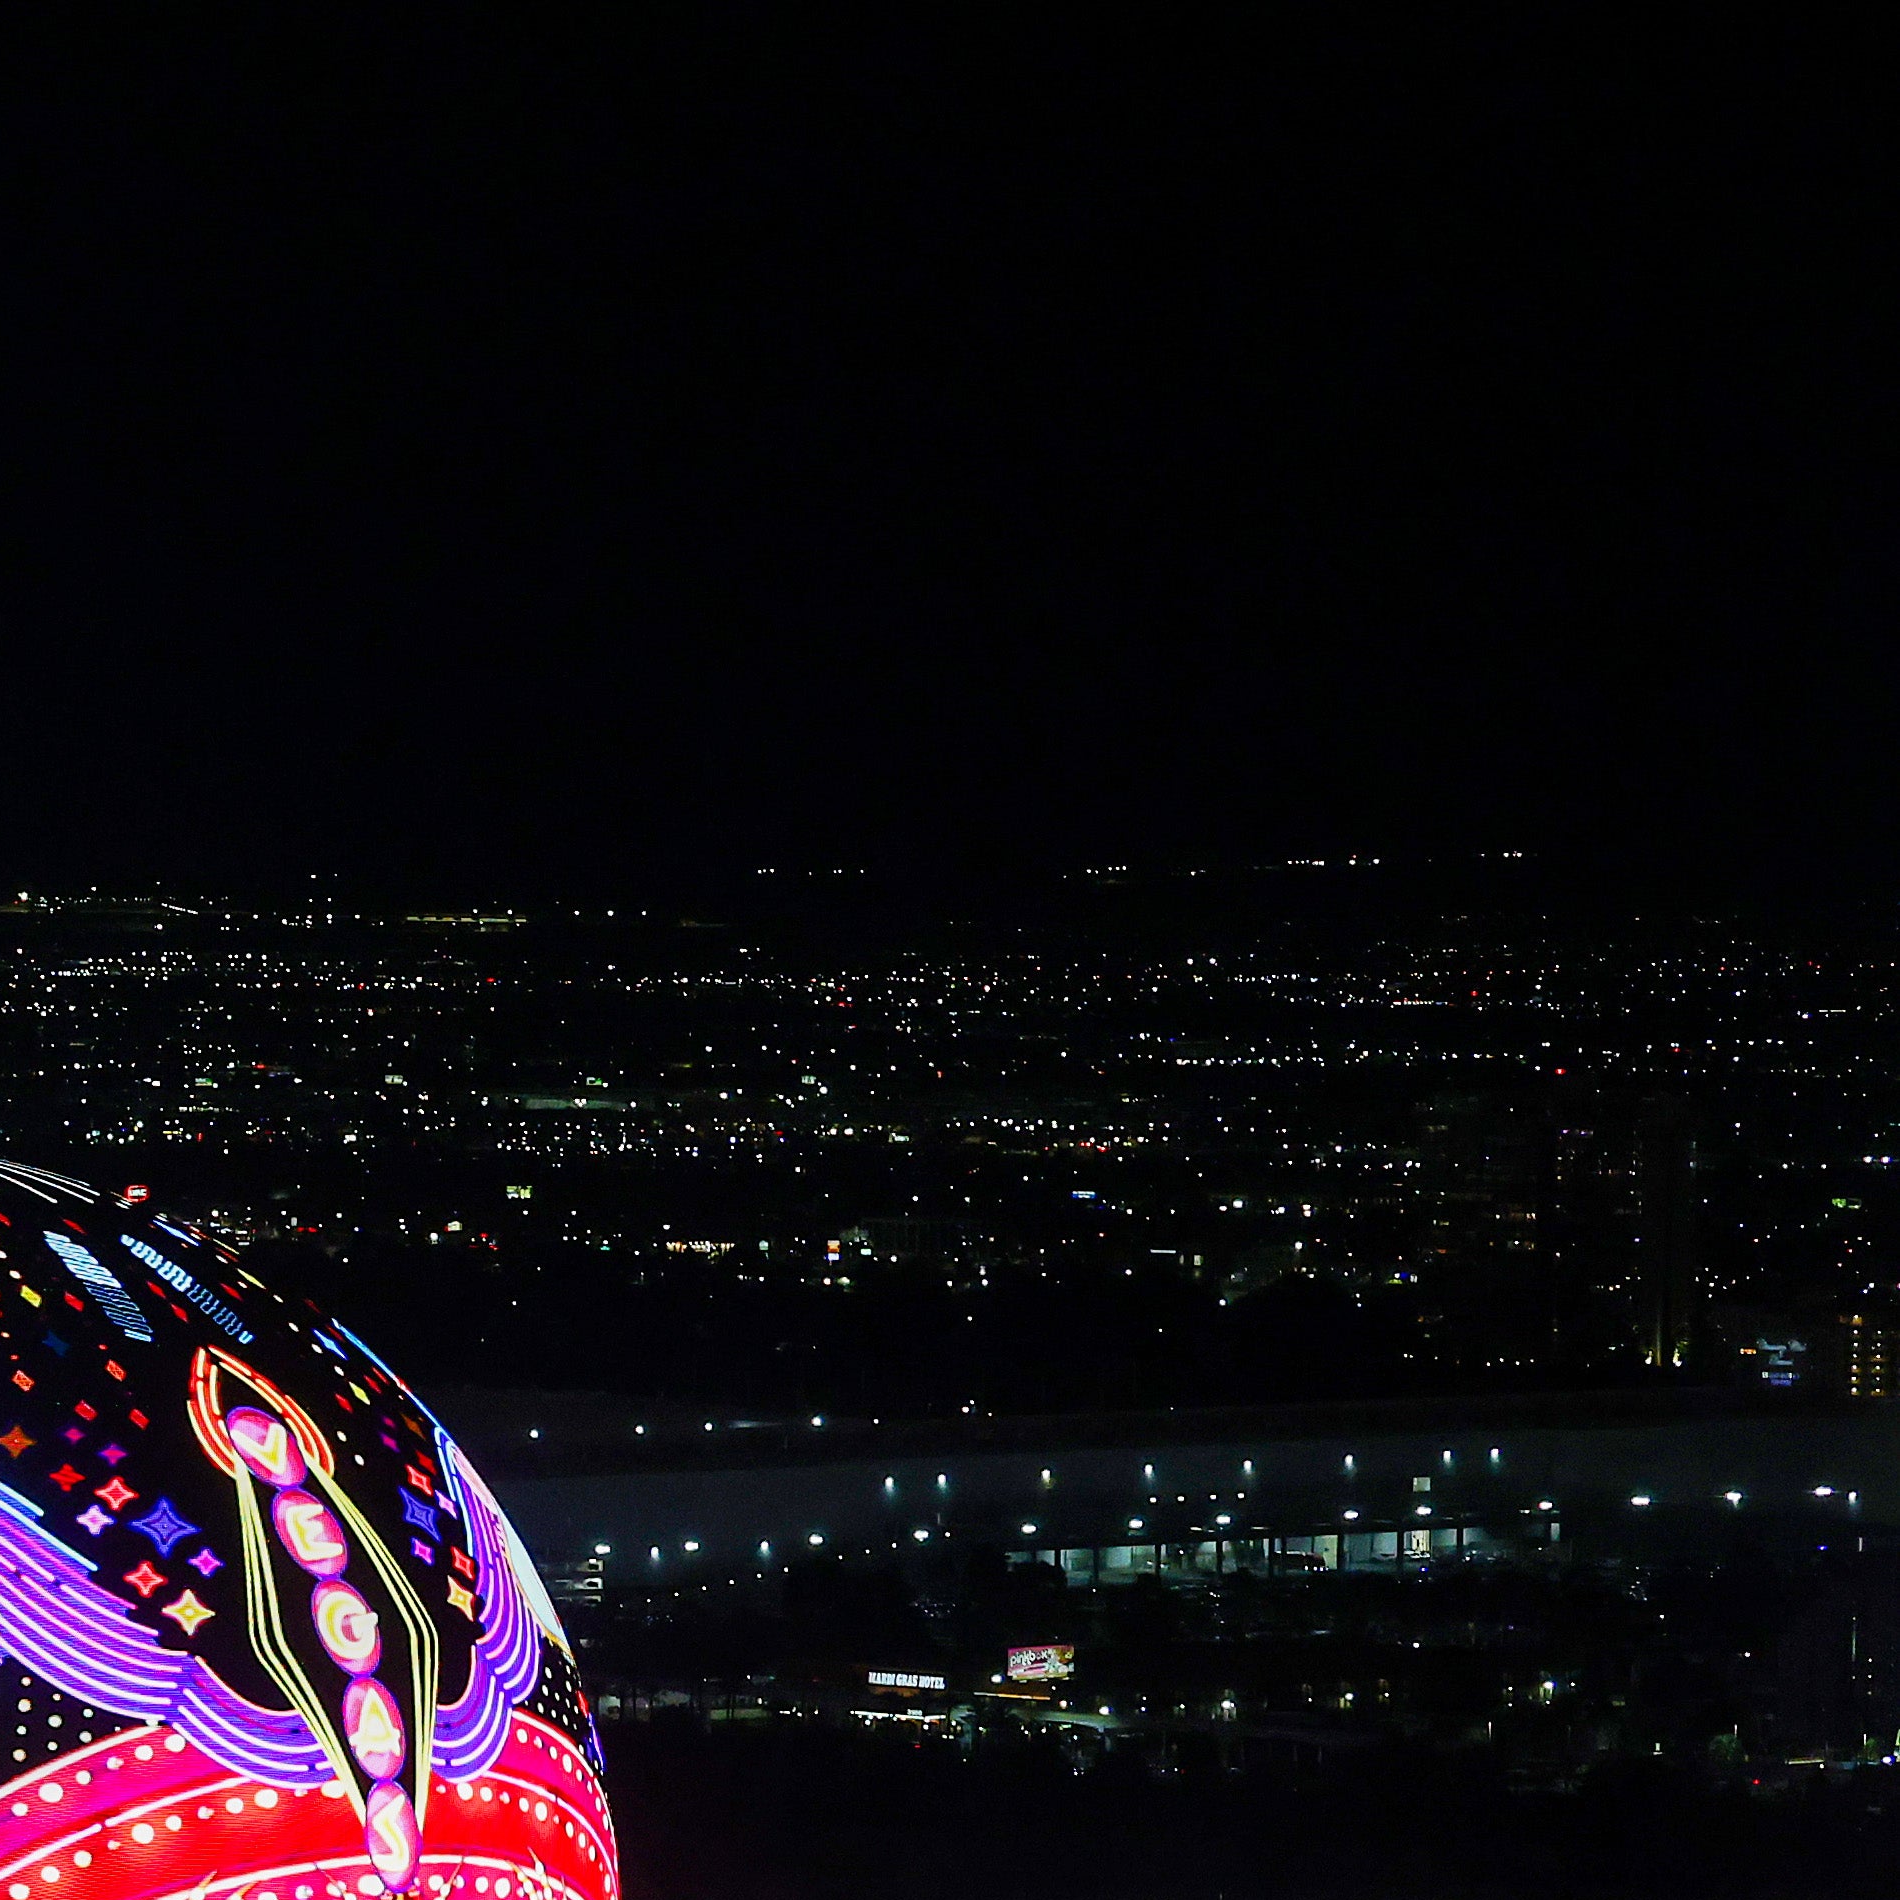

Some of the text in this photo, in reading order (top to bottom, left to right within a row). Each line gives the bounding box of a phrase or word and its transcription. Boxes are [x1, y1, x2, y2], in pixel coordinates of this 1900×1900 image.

[230, 1420, 411, 1873] VEGAS
[868, 1671, 945, 1690] MARDI GRAS HOTEL
